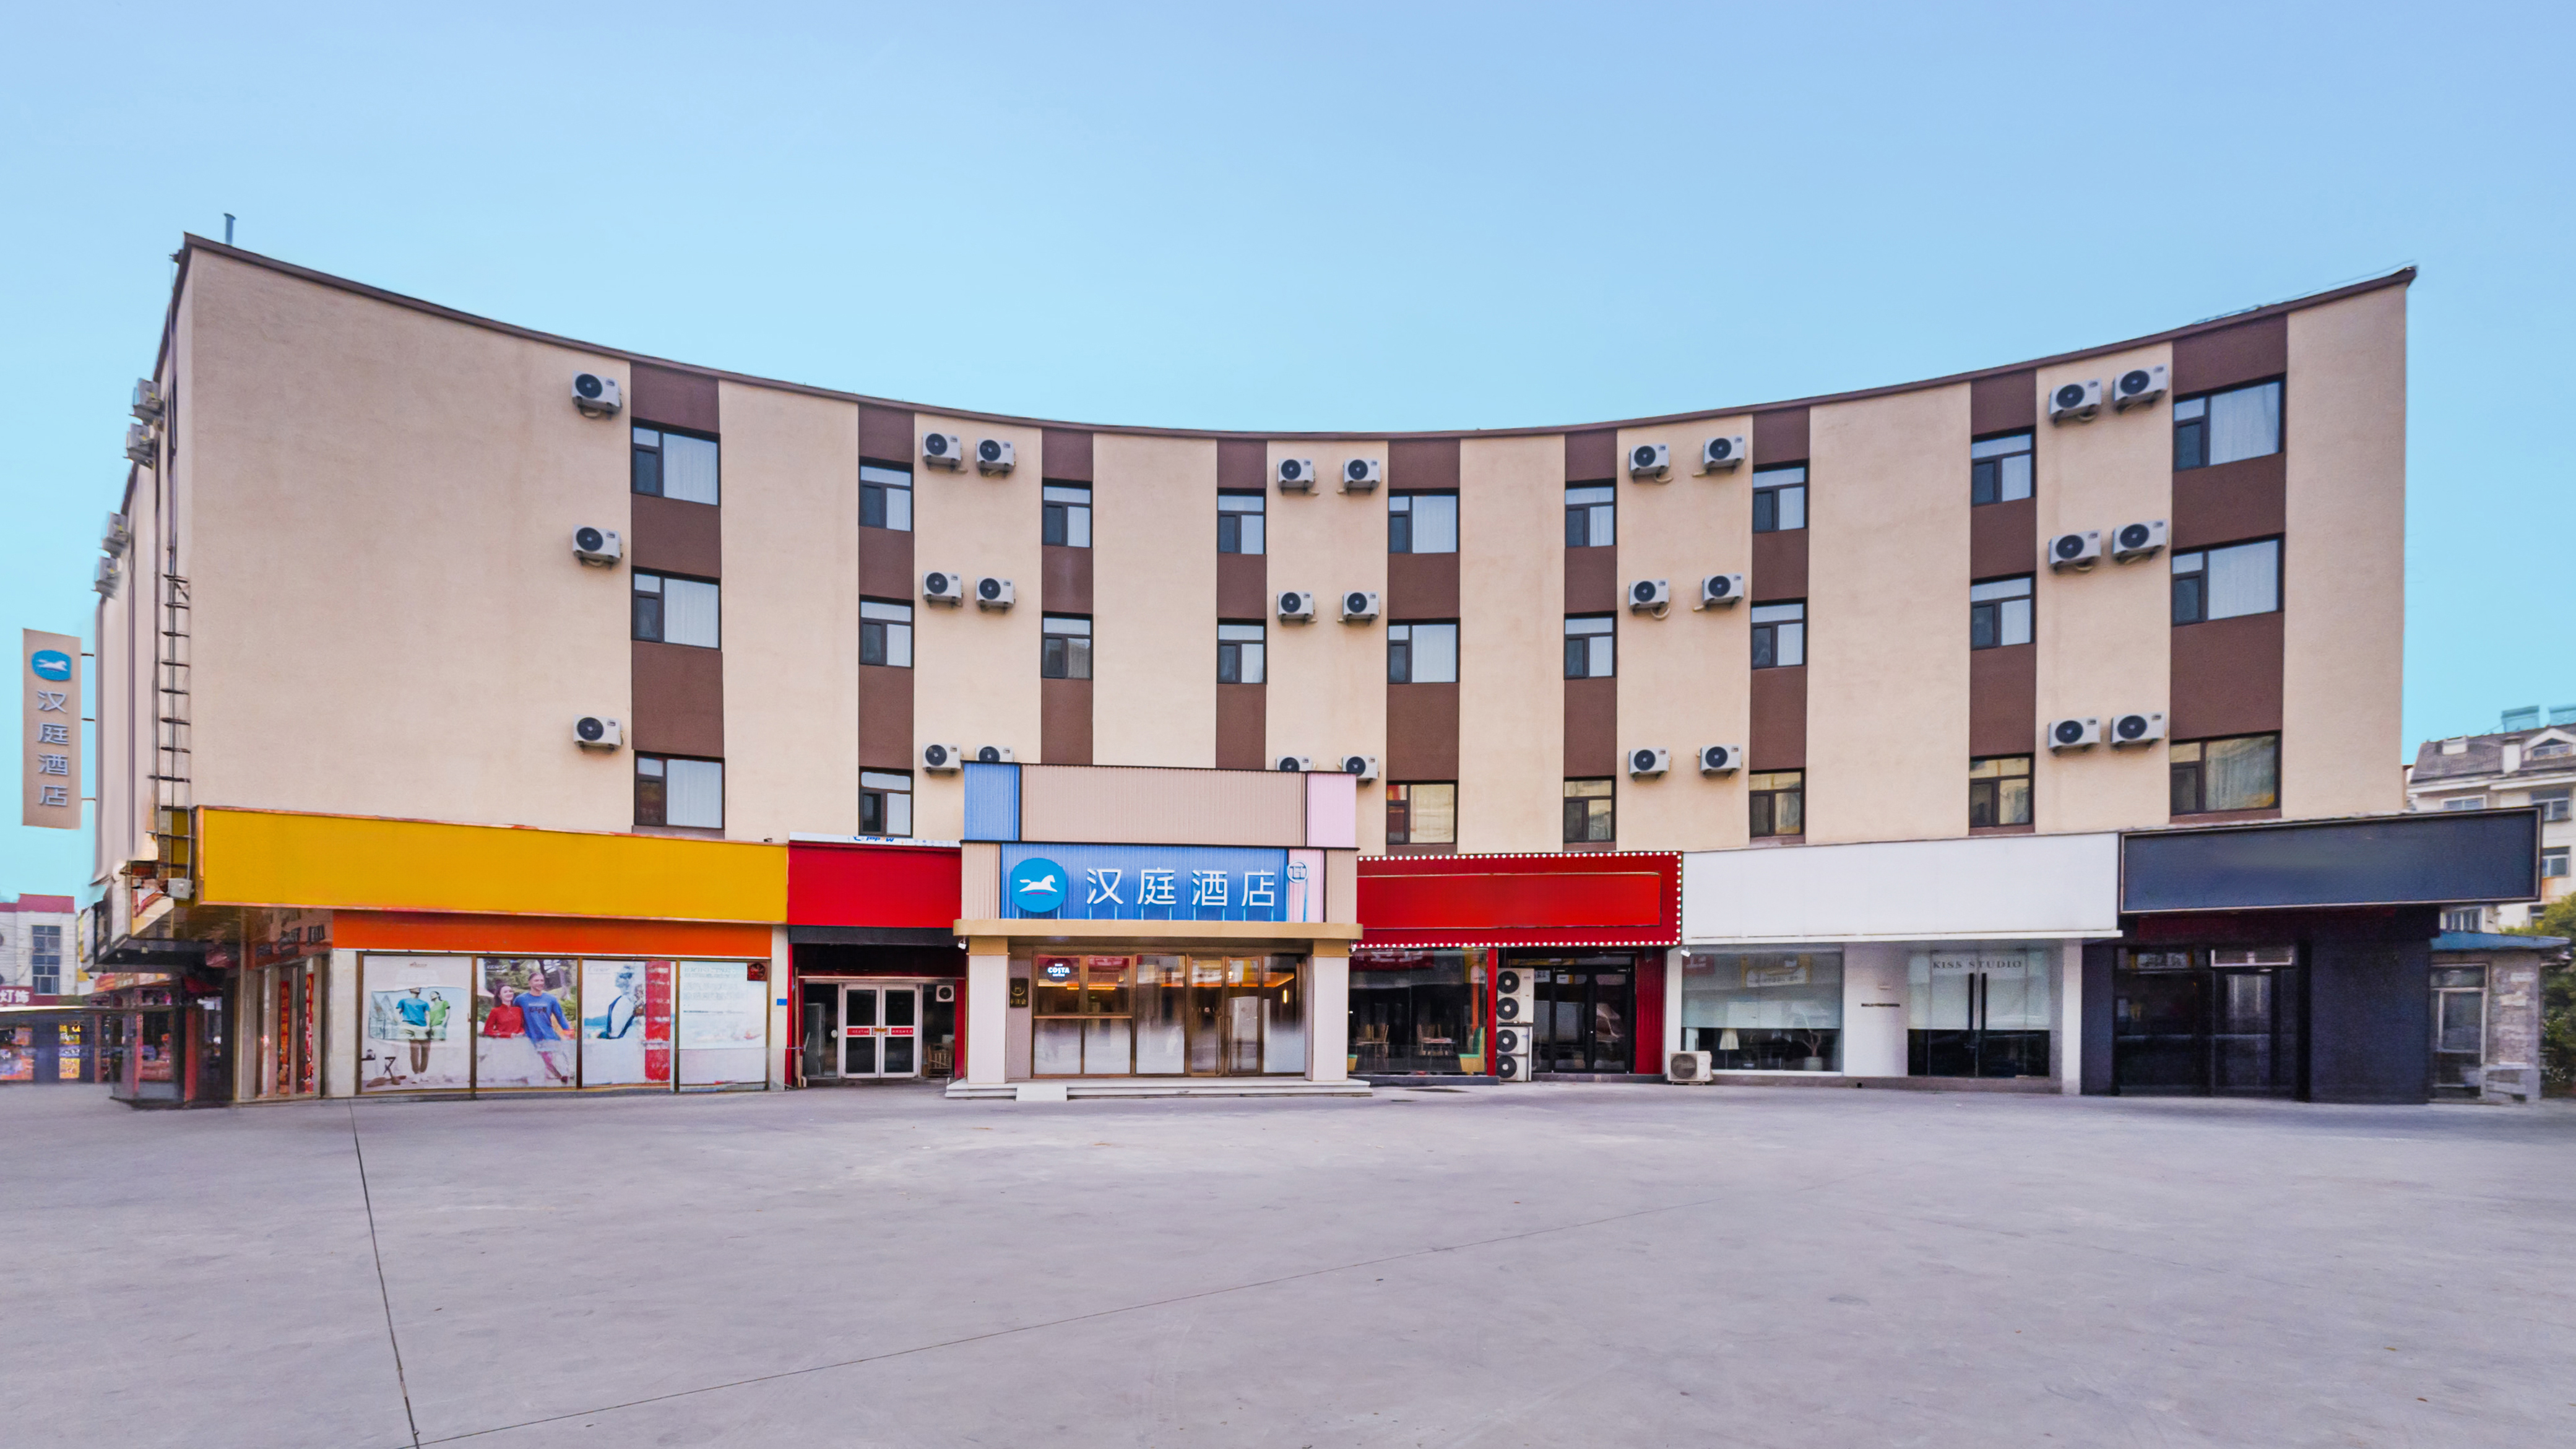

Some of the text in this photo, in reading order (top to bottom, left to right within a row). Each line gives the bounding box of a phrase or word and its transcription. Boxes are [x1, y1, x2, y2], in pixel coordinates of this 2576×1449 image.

[37, 690, 69, 807] 汉庭酒店
[1087, 867, 1275, 907] 汉庭酒店
[1932, 961, 2021, 969] KISS STUDIO
